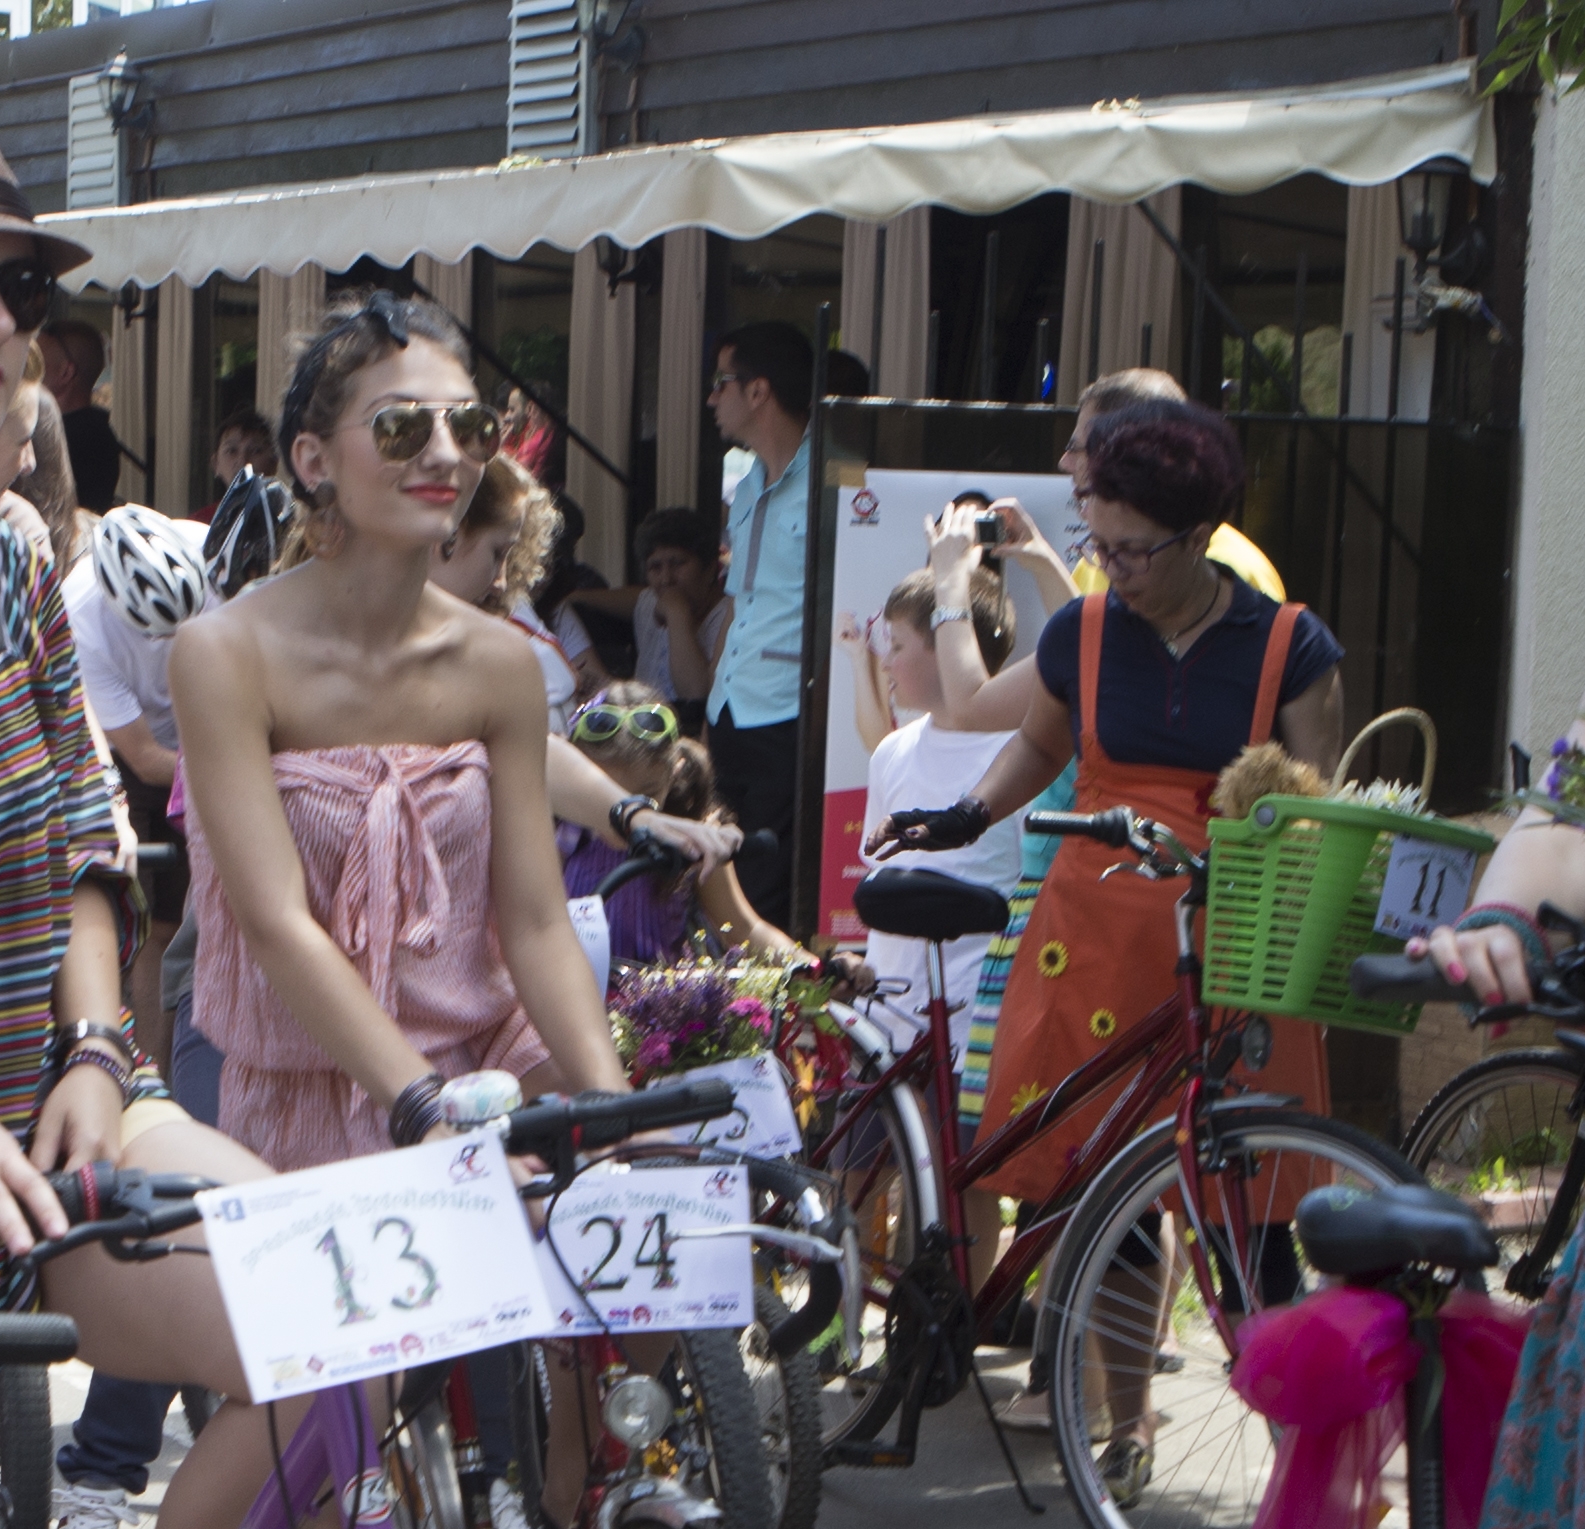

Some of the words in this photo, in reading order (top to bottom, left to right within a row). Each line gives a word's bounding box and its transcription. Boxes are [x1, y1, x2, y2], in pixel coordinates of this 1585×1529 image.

[1409, 861, 1447, 917] 11
[316, 1217, 442, 1327] 13
[580, 1212, 680, 1297] 24
